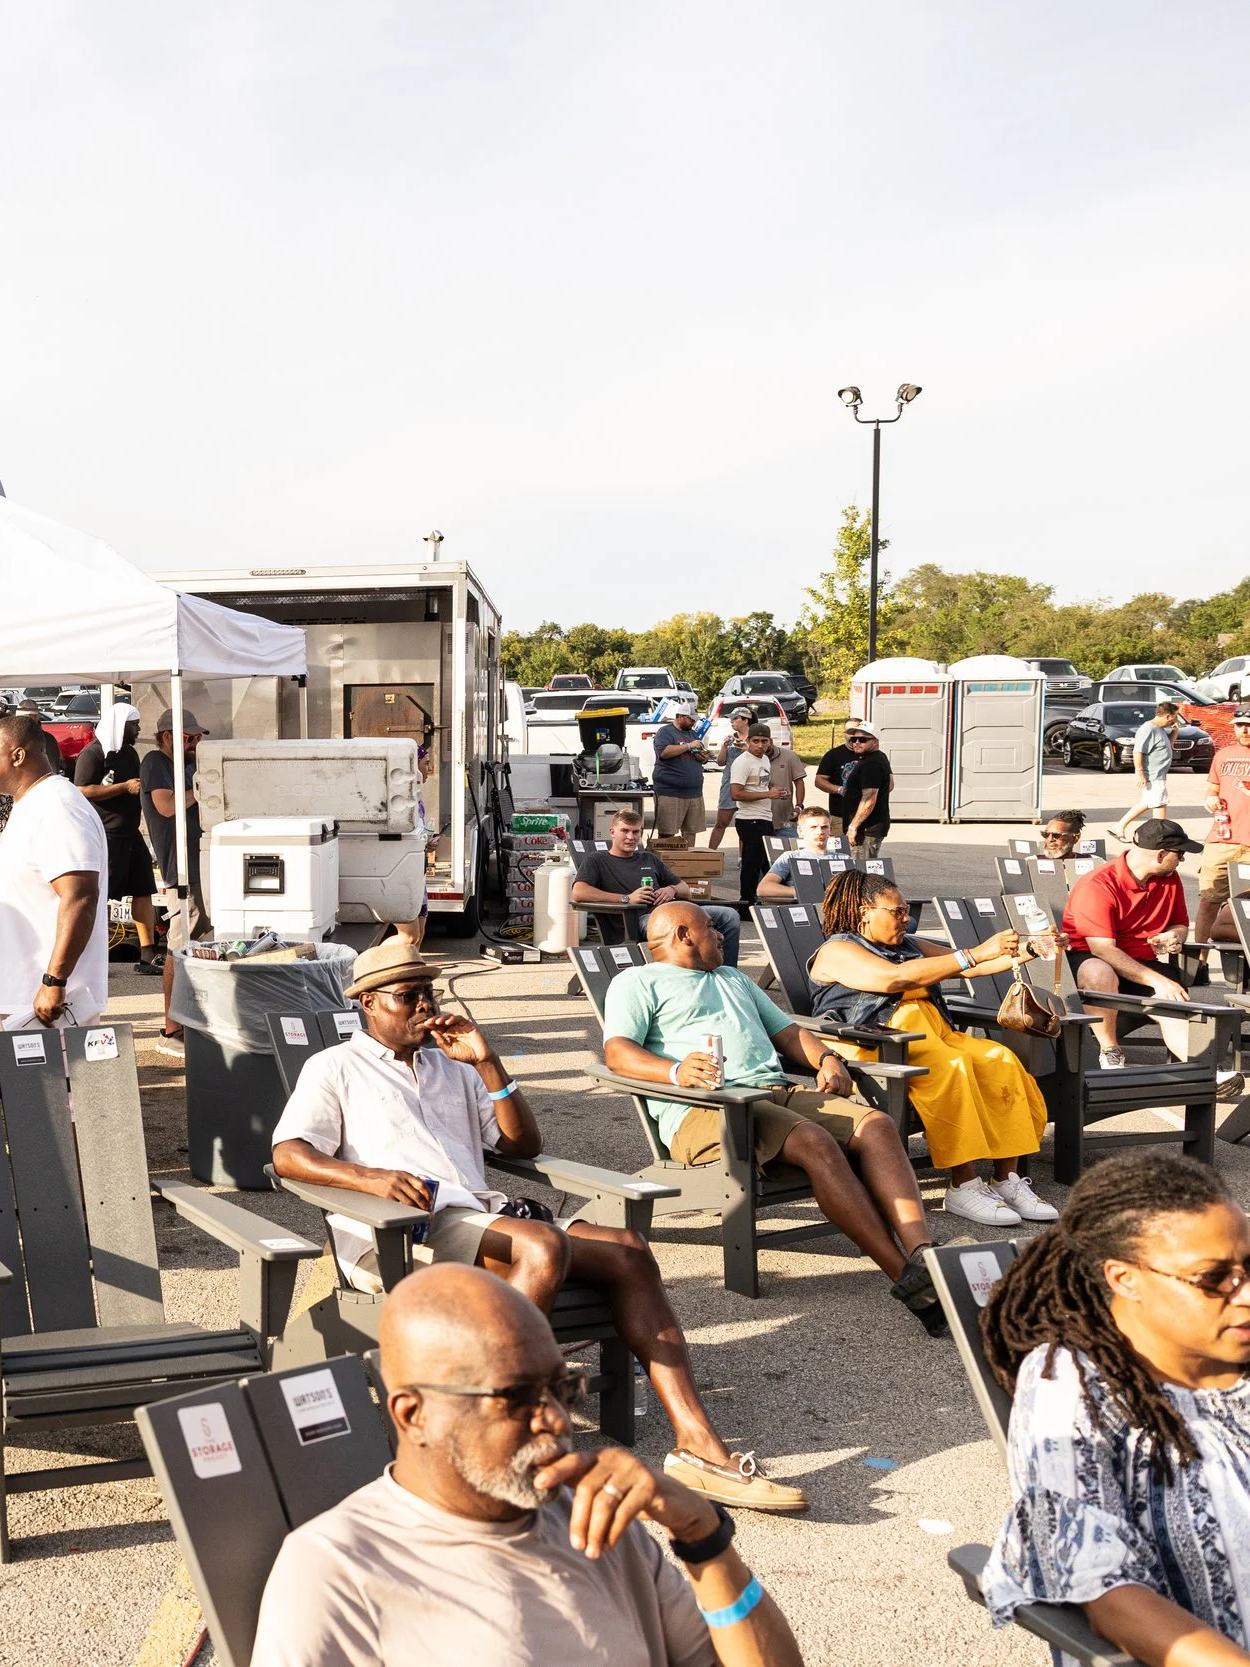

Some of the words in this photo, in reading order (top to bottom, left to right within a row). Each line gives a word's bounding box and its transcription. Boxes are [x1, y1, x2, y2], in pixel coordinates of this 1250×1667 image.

[520, 816, 548, 827] Sprite
[525, 835, 548, 846] Coke
[191, 1441, 234, 1458] STORAGE
